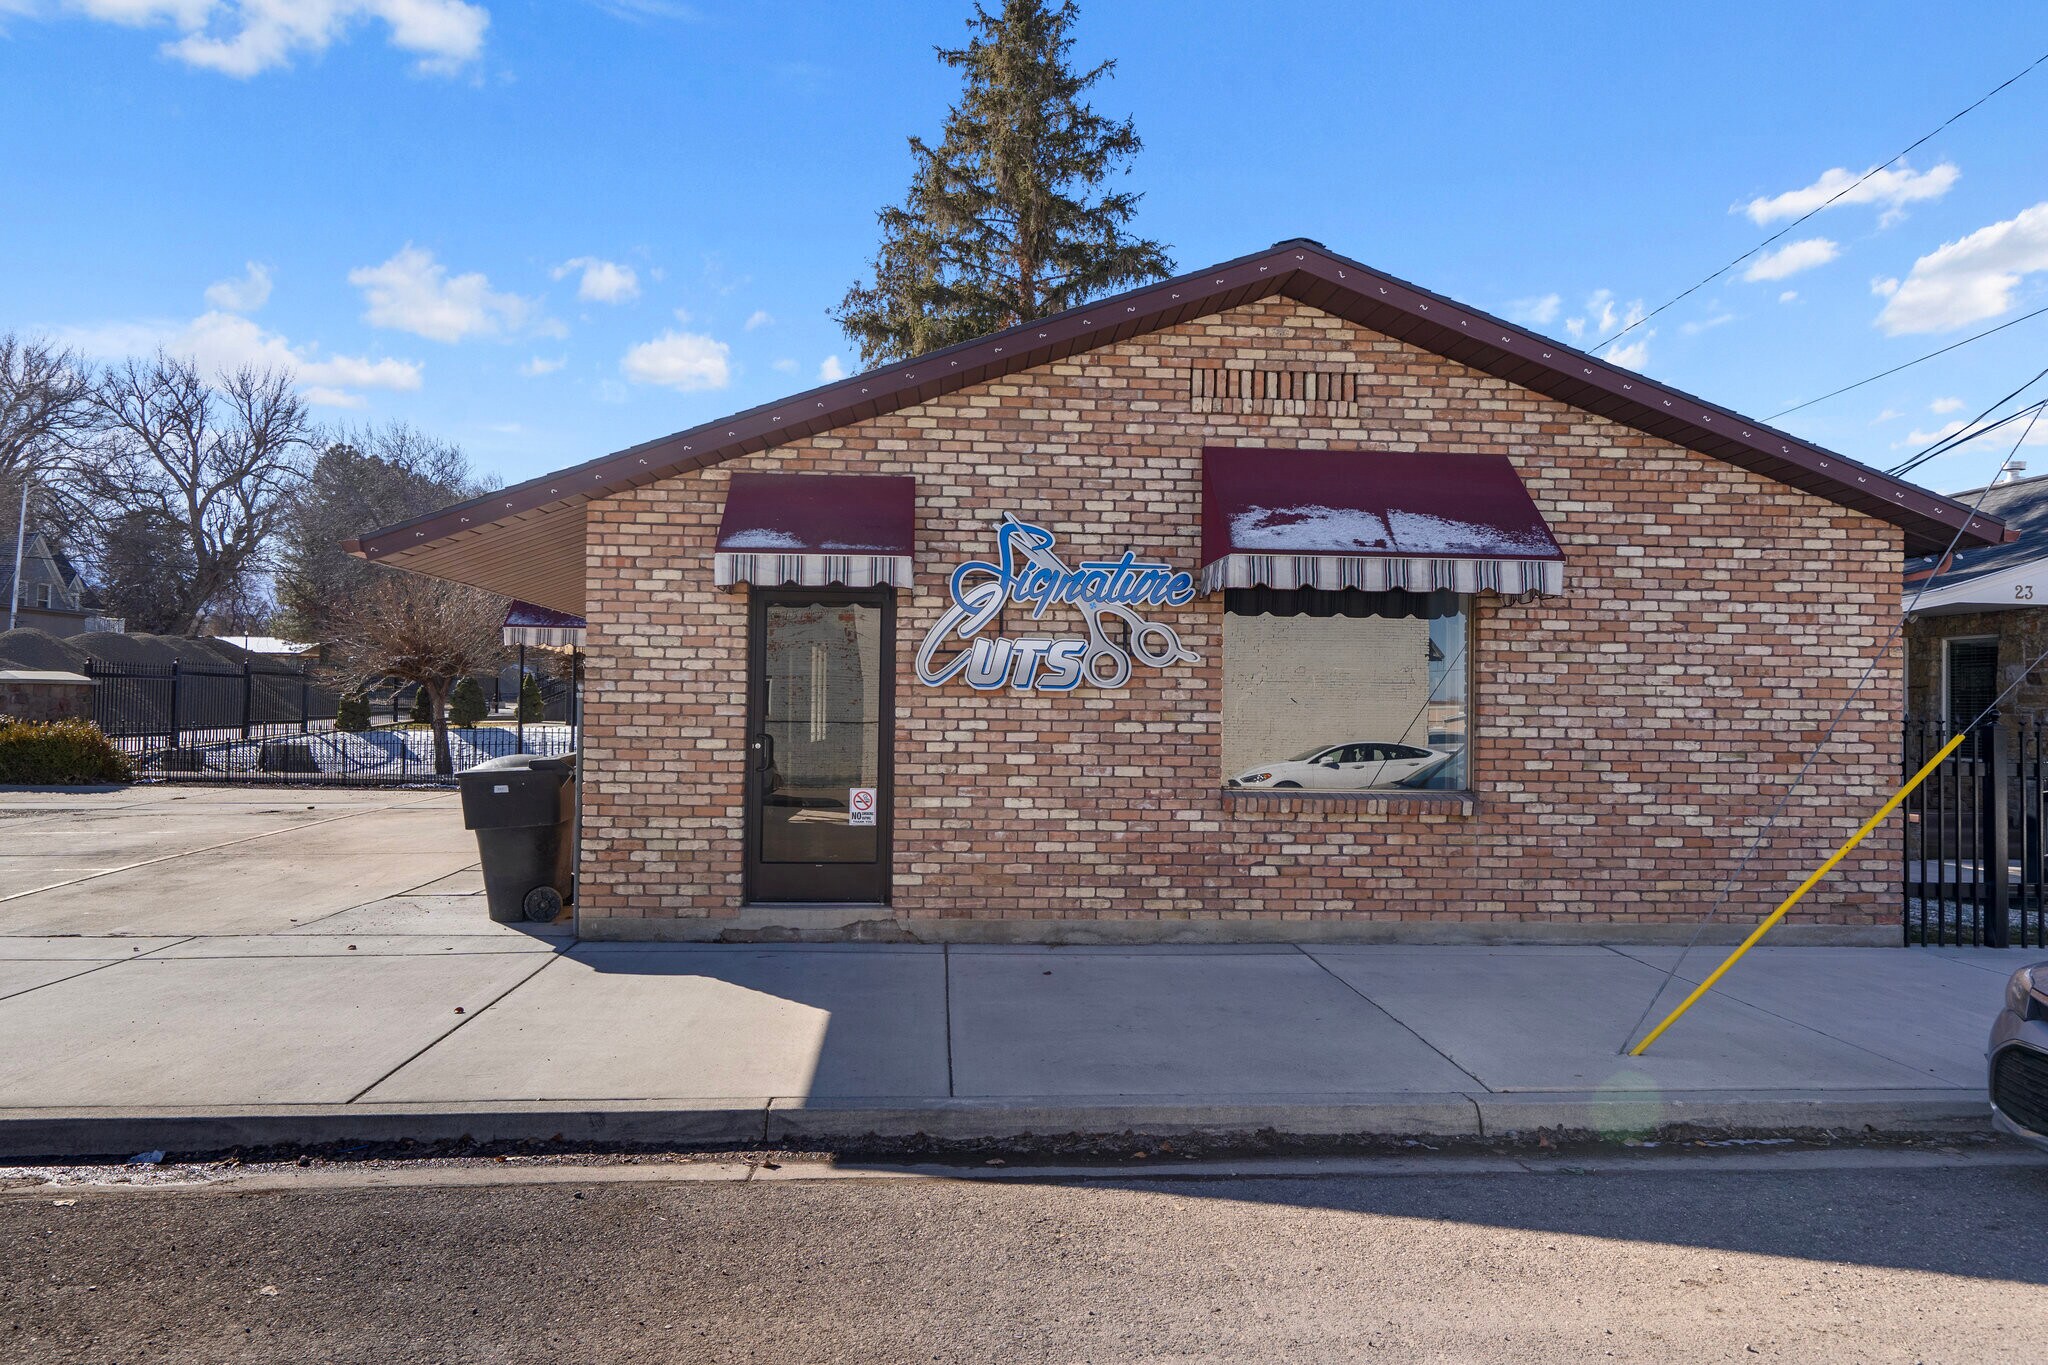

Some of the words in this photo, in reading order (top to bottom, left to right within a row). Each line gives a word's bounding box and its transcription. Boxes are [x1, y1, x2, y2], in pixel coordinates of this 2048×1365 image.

[951, 522, 1196, 620] Signature
[2015, 585, 2033, 599] 23
[851, 811, 862, 820] NO
